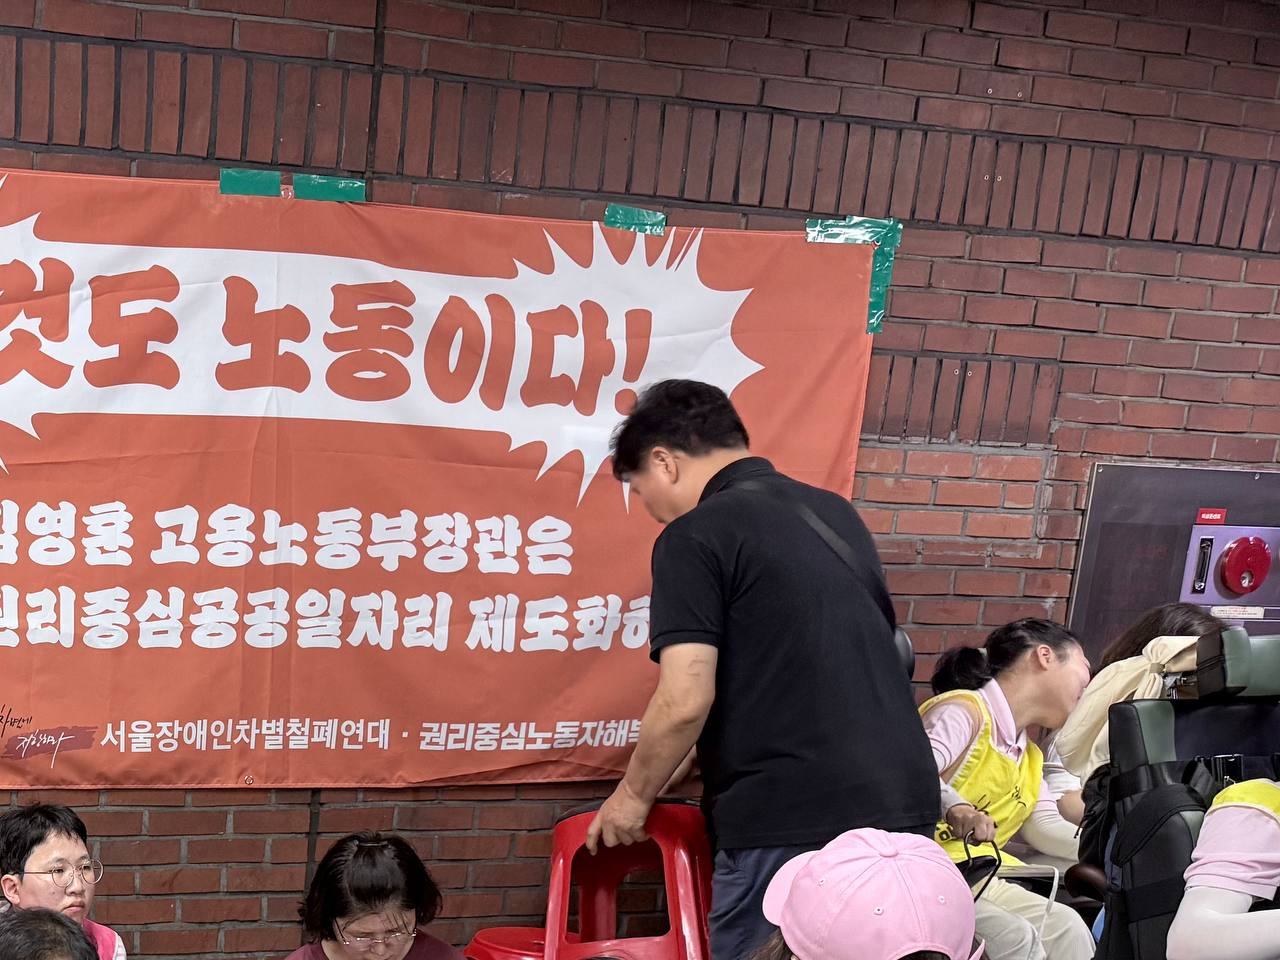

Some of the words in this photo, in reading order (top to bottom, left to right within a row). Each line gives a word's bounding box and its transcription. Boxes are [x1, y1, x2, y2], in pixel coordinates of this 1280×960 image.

[215, 275, 653, 416] 노동이다!
[150, 503, 573, 576] 고용노동부장관은
[100, 718, 390, 752] 서울장애인차별철폐연대
